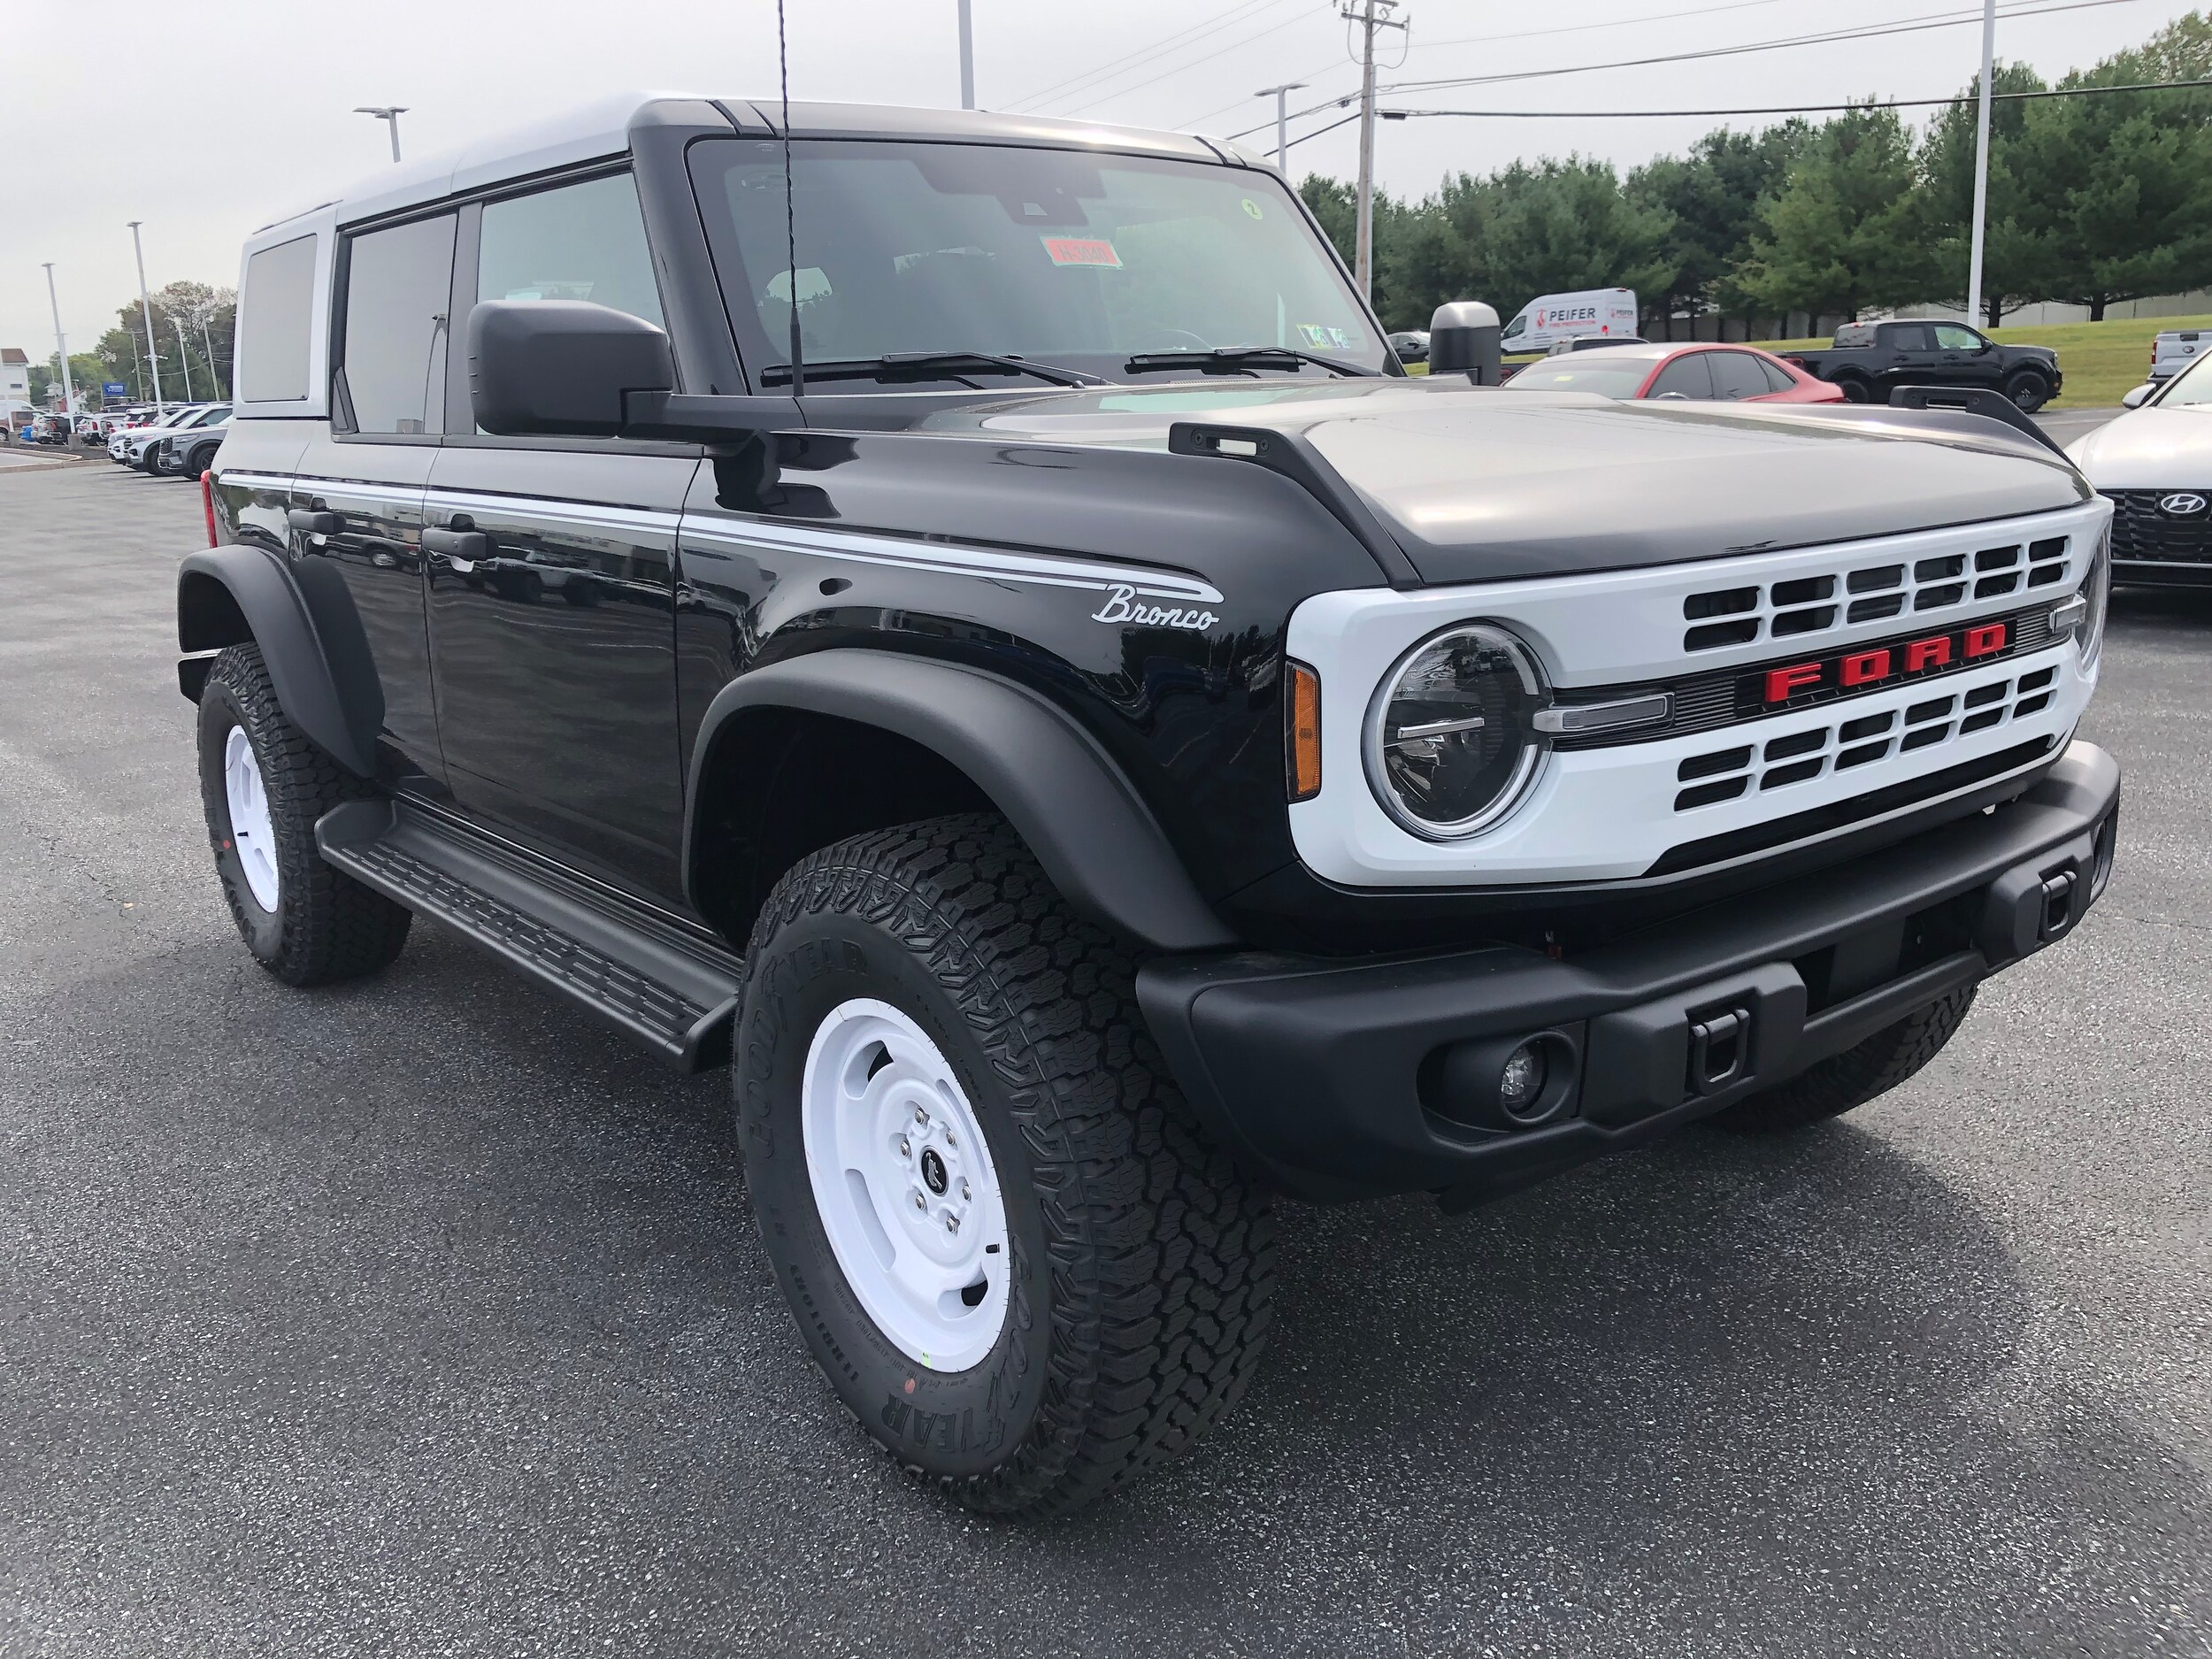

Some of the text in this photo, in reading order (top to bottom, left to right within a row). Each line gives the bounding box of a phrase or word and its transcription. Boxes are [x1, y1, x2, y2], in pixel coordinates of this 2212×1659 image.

[1247, 203, 1258, 215] 2
[1057, 244, 1110, 263] H-3040
[1549, 308, 1596, 321] PEIFER
[1091, 583, 1220, 631] Bronco
[1765, 623, 2006, 703] FORD
